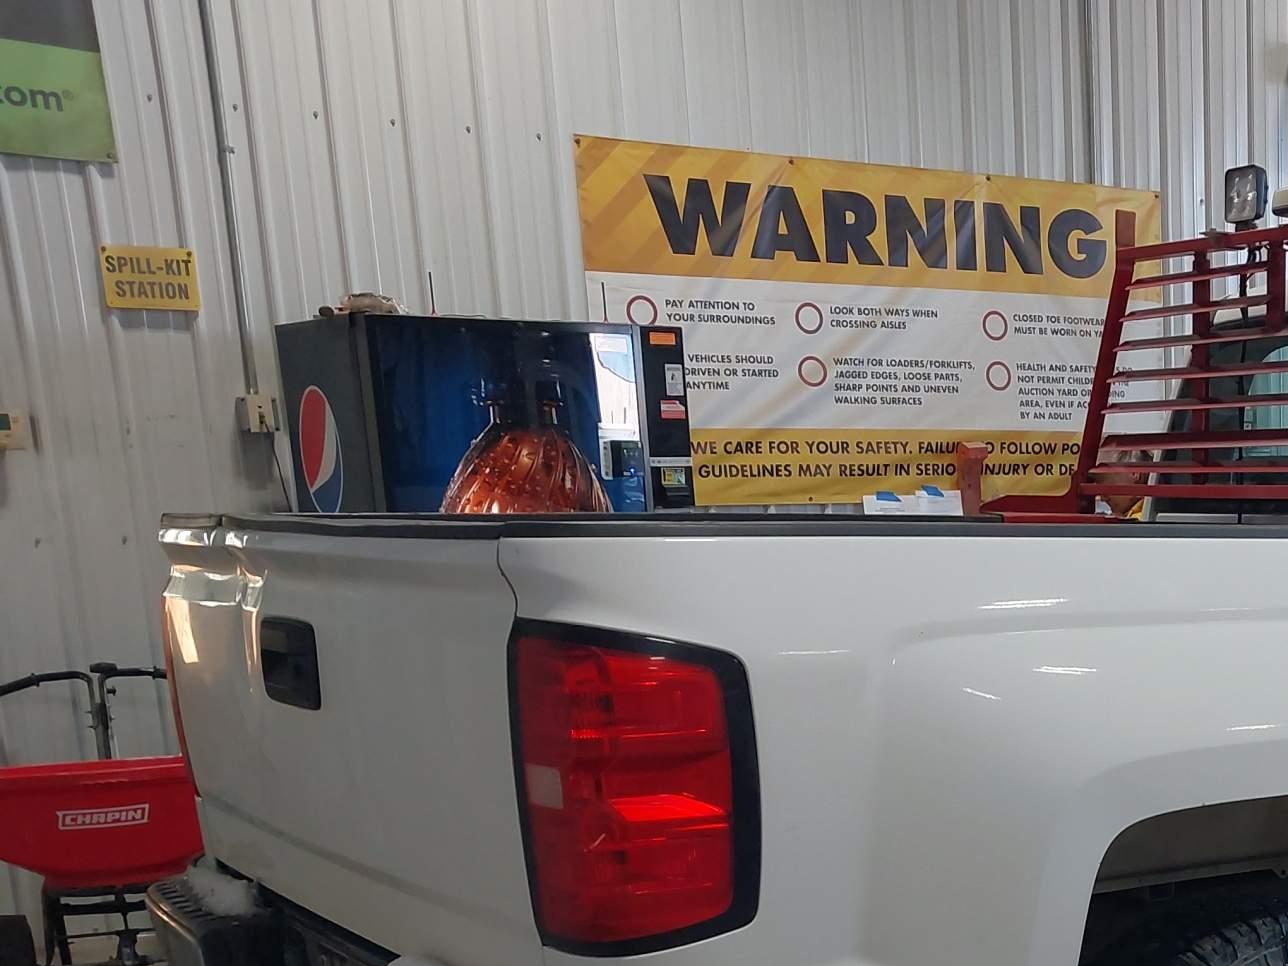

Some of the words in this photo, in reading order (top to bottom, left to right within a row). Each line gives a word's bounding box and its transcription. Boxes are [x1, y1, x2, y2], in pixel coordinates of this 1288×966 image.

[0, 86, 64, 112] om
[643, 173, 1108, 280] WARNING
[105, 255, 191, 276] SPILL-KIT
[115, 280, 190, 300] STATION
[665, 299, 684, 309] PAY
[688, 300, 740, 311] ATTENTION
[742, 302, 755, 311] TO
[830, 306, 854, 316] LOOK
[857, 307, 881, 317] BOTH
[885, 308, 910, 317] WAYS
[912, 309, 938, 319] WHEN
[1013, 313, 1044, 323] CLOSED
[1046, 315, 1061, 324] TOE
[666, 313, 698, 323] YOUR
[698, 313, 776, 325] SURROUNDINGS
[830, 319, 877, 329] CROSSING
[880, 320, 907, 330] AISLES
[1014, 326, 1036, 335] MUST
[1039, 327, 1048, 335] BE
[1050, 328, 1077, 337] WORN
[1080, 329, 1092, 338] ON
[688, 354, 732, 364] VEHICLES
[735, 355, 774, 365] SHOULD
[833, 357, 864, 367] WATCH
[867, 358, 883, 367] FOR
[886, 359, 975, 371] LOADERS/FORKLIFTS,
[723, 368, 739, 377] OR
[741, 368, 779, 378] STARTED
[1016, 363, 1046, 372] HEALTH
[1049, 364, 1067, 372] AND
[835, 371, 868, 380] JAGGED
[871, 371, 901, 381] EDGES,
[904, 372, 931, 381] LOOSE
[934, 373, 963, 383] PARTS,
[1017, 375, 1035, 384] NOT
[1037, 376, 1065, 384] PERMIT
[1068, 376, 1094, 385] CHILD
[686, 381, 730, 391] ANYTIME
[834, 383, 863, 392] SHARP
[866, 384, 898, 393] POINTS
[901, 384, 921, 393] AND
[923, 385, 959, 394] UNEVEN
[1018, 388, 1054, 396] AUCTION
[1057, 388, 1078, 397] YARD
[834, 395, 877, 405] WALKING
[880, 396, 922, 406] SURFACES
[1019, 400, 1043, 409] AREA,
[1045, 400, 1065, 408] EVEN
[1068, 400, 1075, 409] IF
[1020, 411, 1030, 420] BY
[1033, 412, 1045, 420] AN
[1048, 412, 1072, 421] ADULT
[690, 440, 717, 455] WE
[723, 441, 763, 455] CARE
[768, 441, 800, 455] FOR
[805, 441, 850, 455] YOUR
[855, 441, 913, 455] SAFETY.
[918, 441, 959, 455] FAILU
[1000, 441, 1057, 455] FOLLOW
[698, 464, 793, 478] GUIDELINES
[798, 464, 832, 477] MAY
[839, 463, 890, 477] RESULT
[894, 463, 915, 476] IN
[915, 463, 956, 476] SERIO
[980, 463, 1030, 476] INJURY
[1034, 463, 1054, 476] OR
[64, 809, 143, 825] CHAPIN
